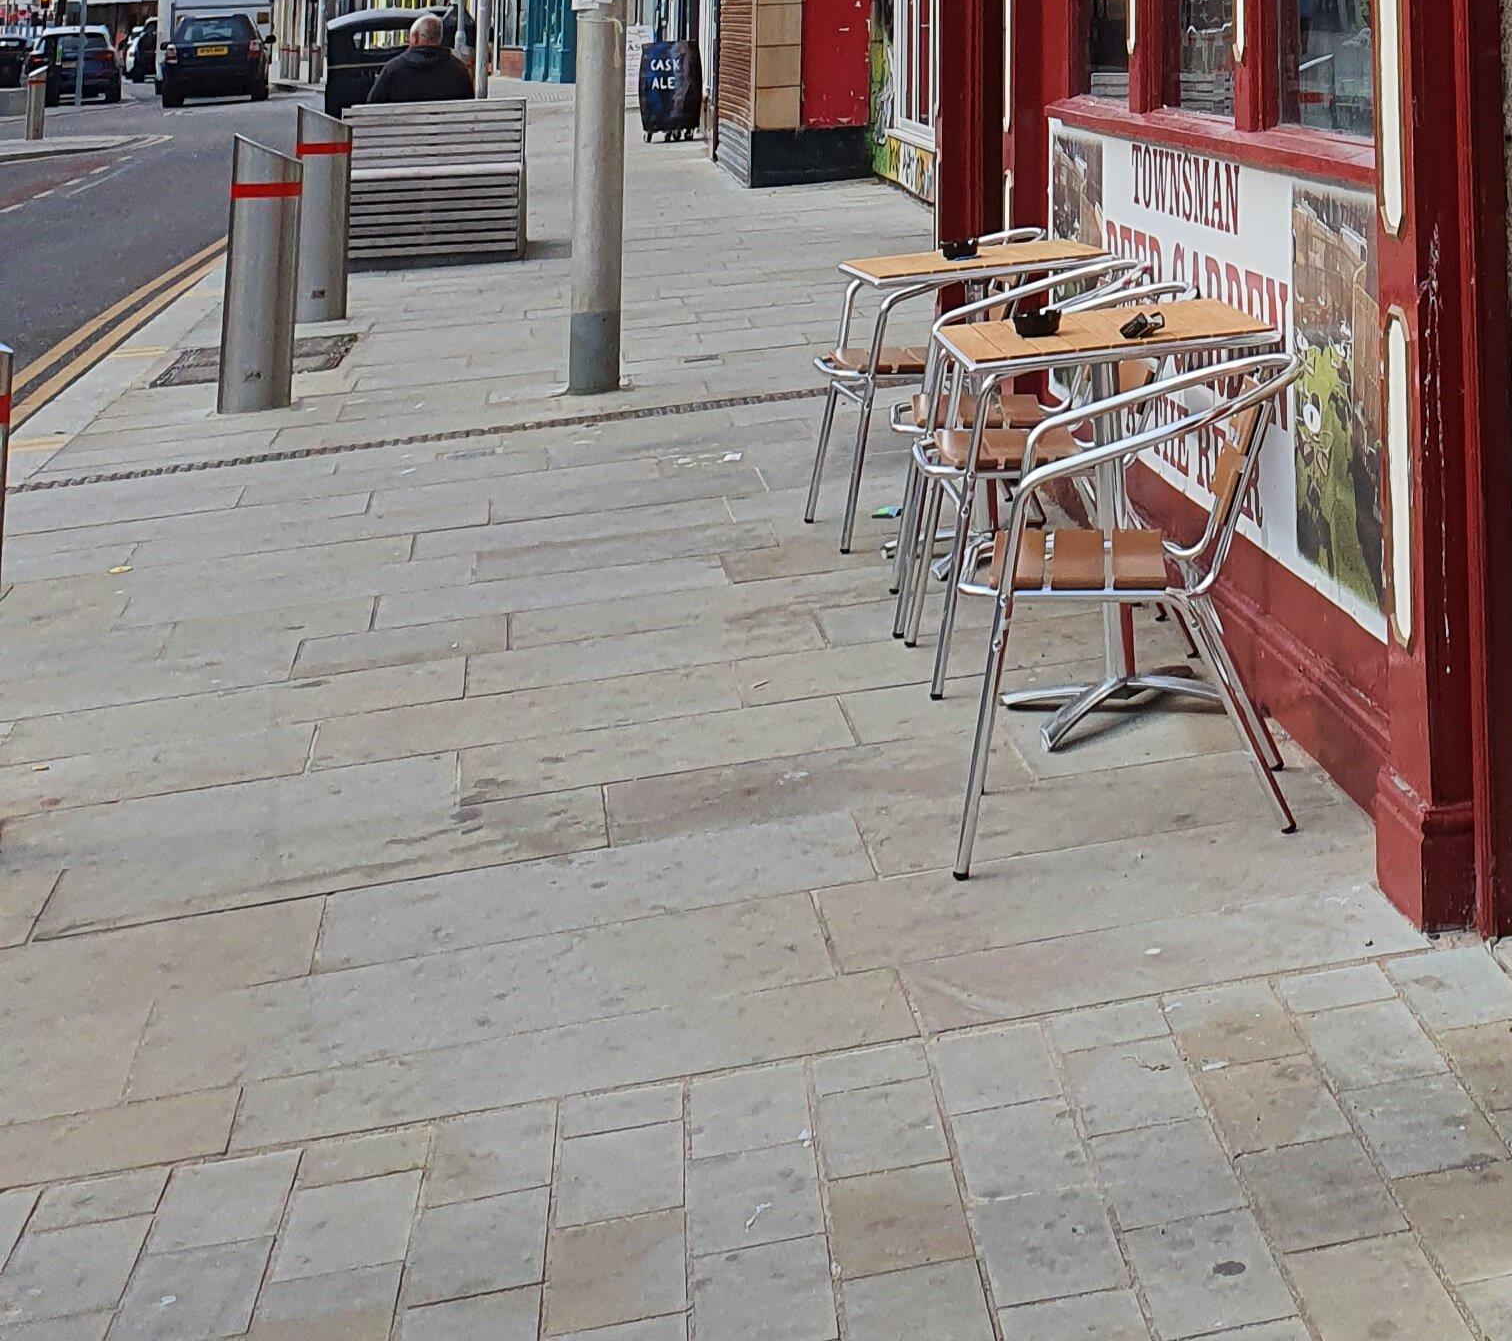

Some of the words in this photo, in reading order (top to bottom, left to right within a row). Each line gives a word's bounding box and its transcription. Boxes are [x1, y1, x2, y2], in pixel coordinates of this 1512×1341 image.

[650, 58, 681, 72] CASK
[651, 75, 676, 90] ALE
[1131, 143, 1240, 236] TOWNSMAN
